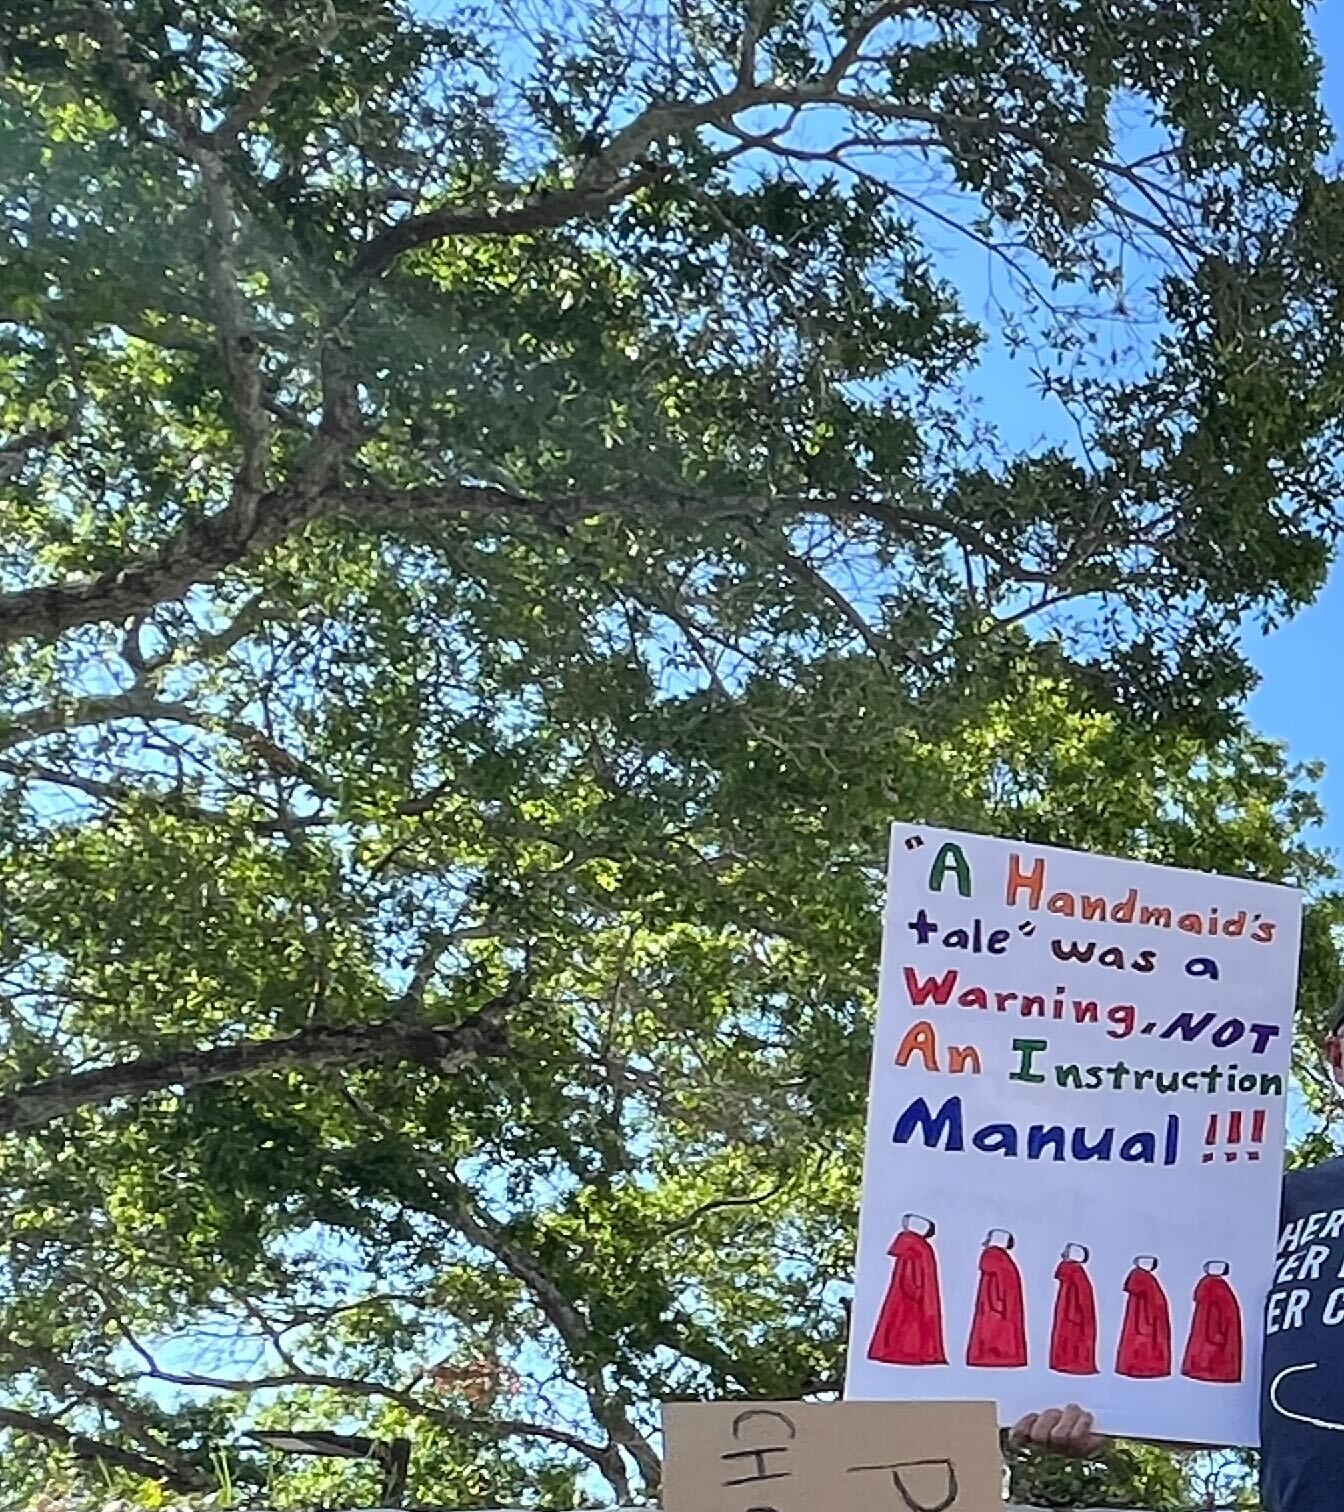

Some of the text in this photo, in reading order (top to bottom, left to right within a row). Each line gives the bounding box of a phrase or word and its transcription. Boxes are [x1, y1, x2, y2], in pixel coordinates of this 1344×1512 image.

[1005, 853, 1276, 943] Handmaid's
[1051, 939, 1157, 973] was
[1185, 956, 1220, 981] a
[1160, 1012, 1280, 1054] NOT
[895, 1021, 1283, 1096] An Instruction
[893, 1096, 1180, 1166] Manual
[1276, 1244, 1330, 1284] ER
[1266, 1288, 1311, 1336] ER
